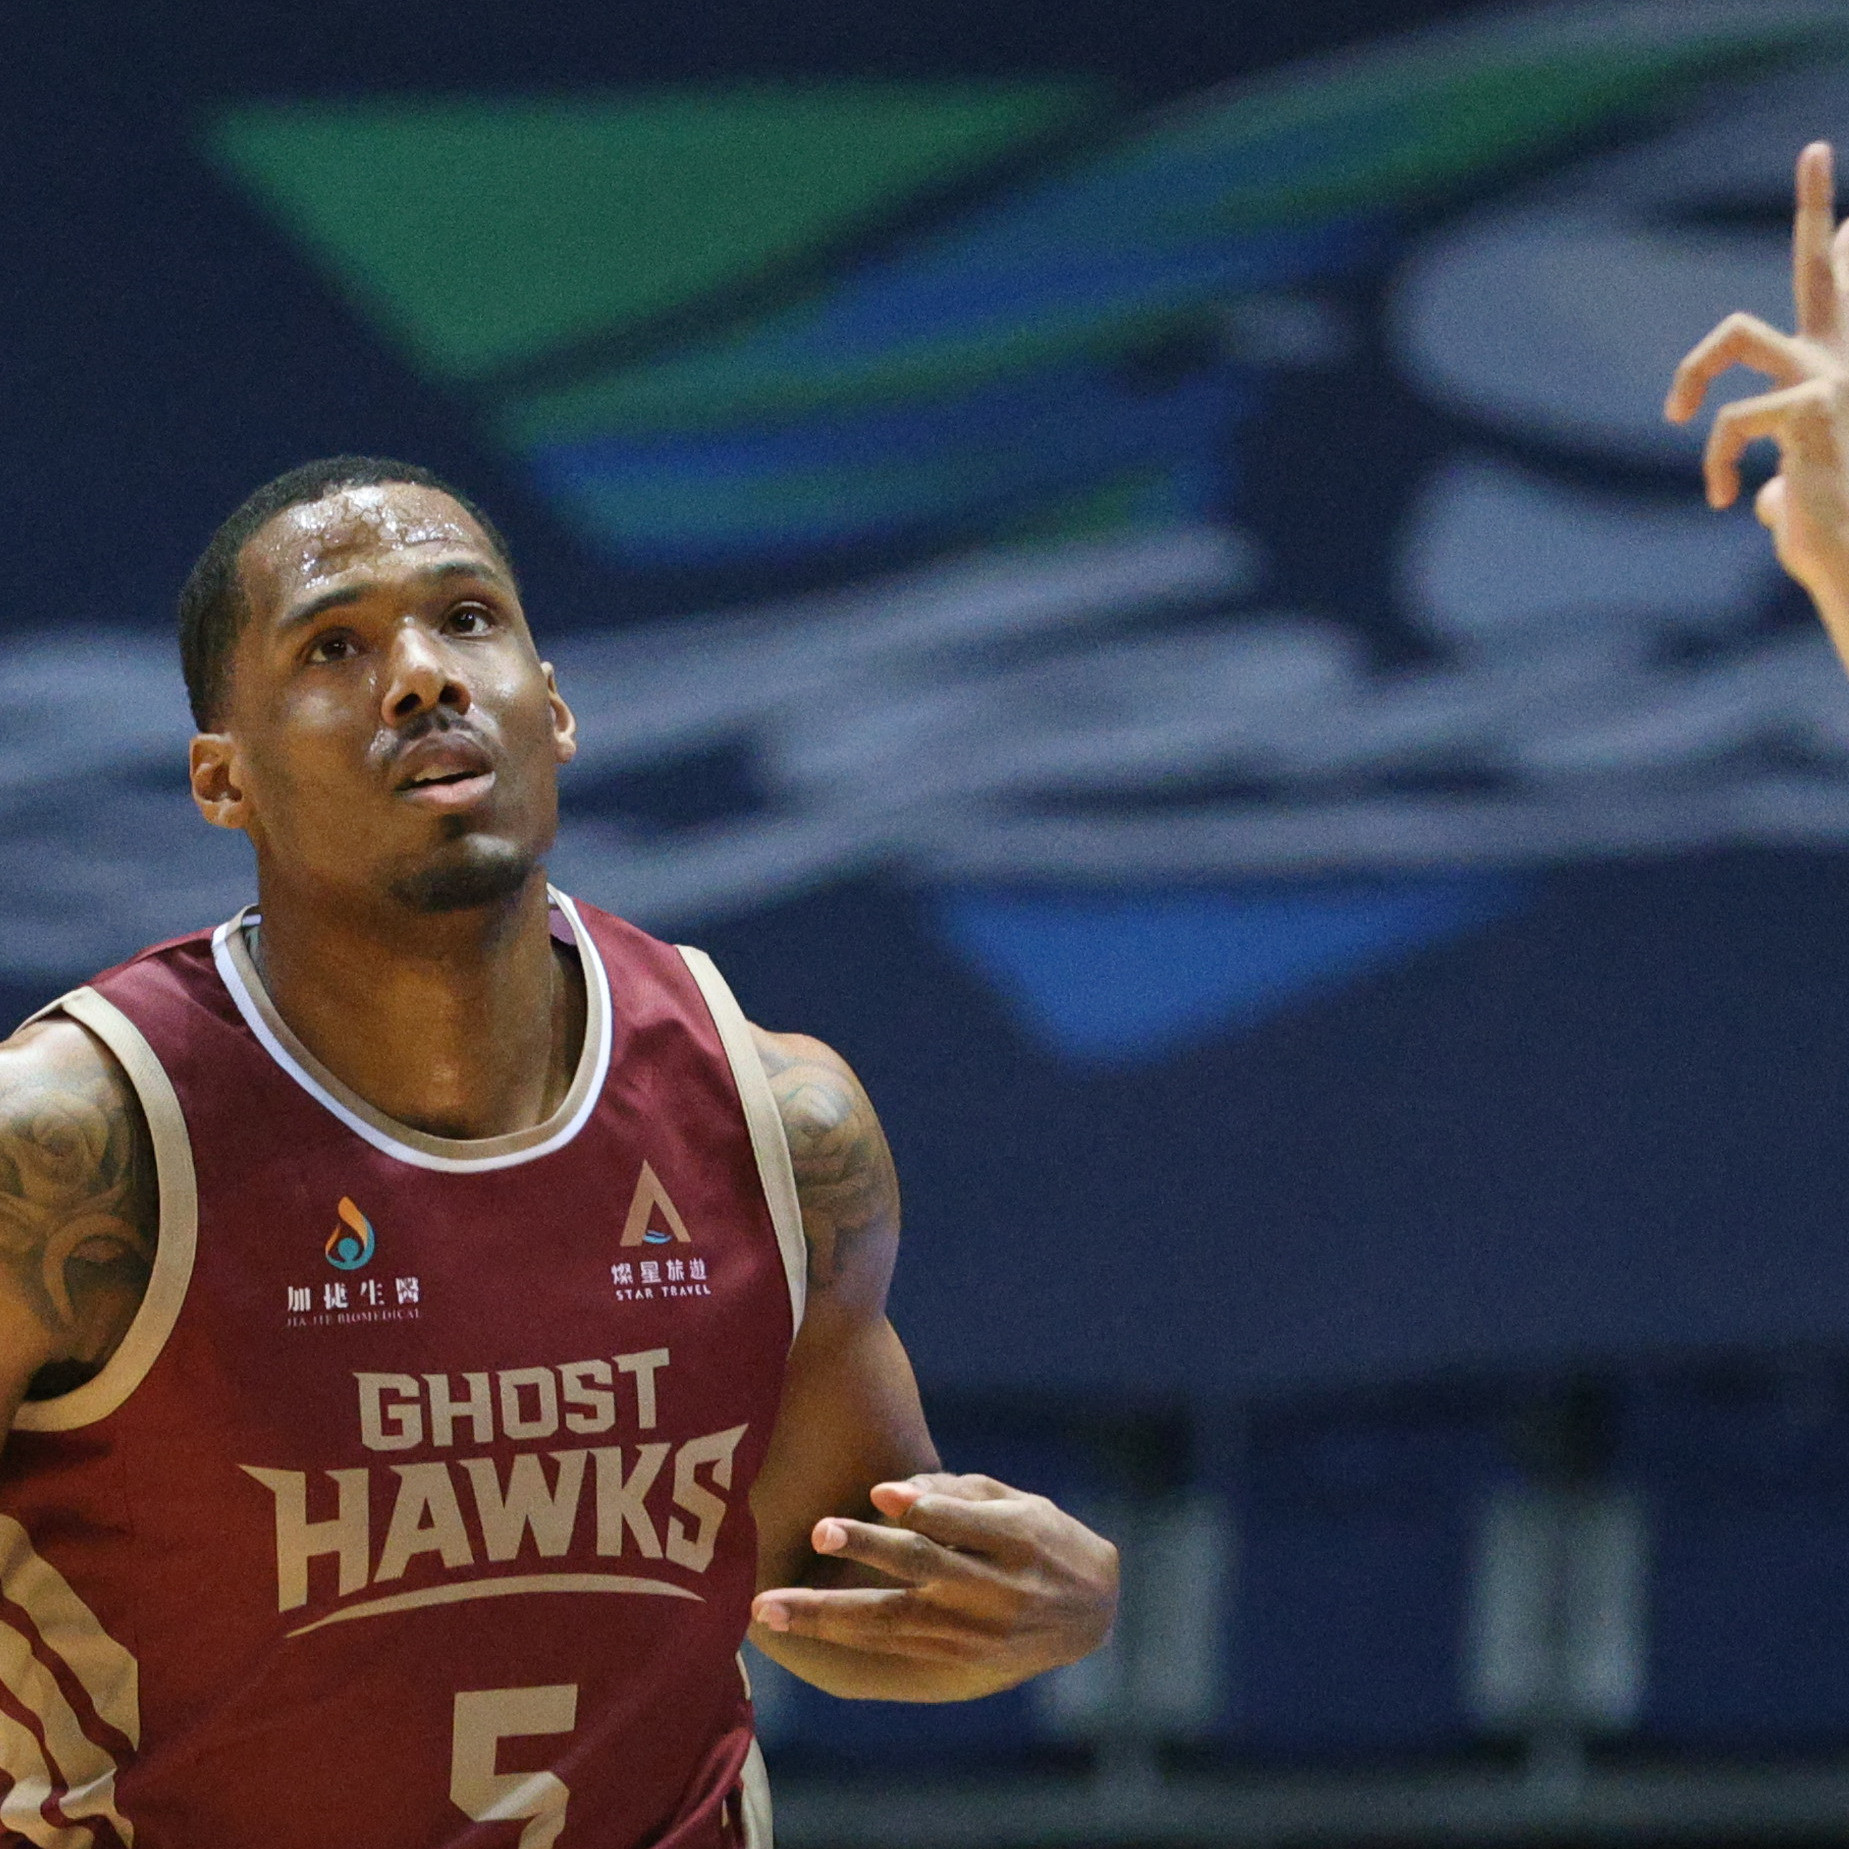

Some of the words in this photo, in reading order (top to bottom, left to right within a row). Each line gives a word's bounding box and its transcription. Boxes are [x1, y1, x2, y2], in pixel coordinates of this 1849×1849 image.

[615, 1287, 654, 1301] STAR
[661, 1283, 712, 1298] TRAVEL
[353, 1347, 670, 1452] GHOST
[237, 1422, 750, 1614] HAWKS
